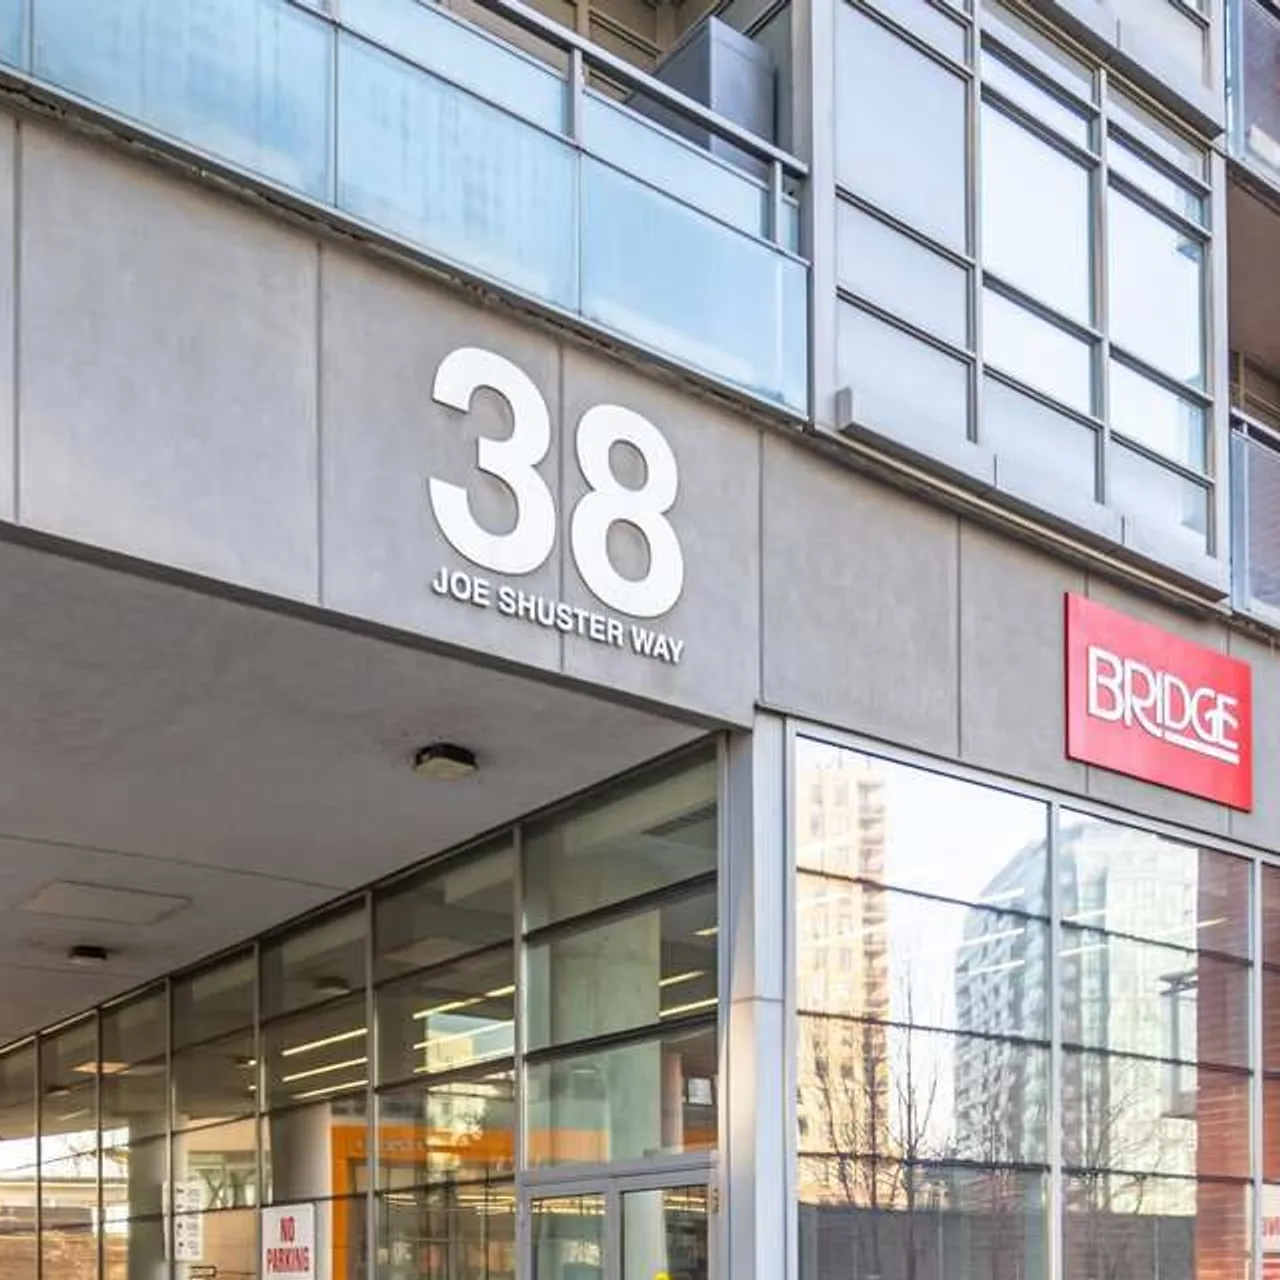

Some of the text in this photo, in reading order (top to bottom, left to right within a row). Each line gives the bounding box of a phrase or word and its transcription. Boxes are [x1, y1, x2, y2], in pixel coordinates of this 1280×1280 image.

[429, 347, 683, 617] 38
[432, 567, 684, 663] JOE SHUSTER WAY
[1088, 646, 1239, 764] BRIDGE
[267, 1247, 309, 1272] PARKING
[280, 1216, 295, 1242] NO
